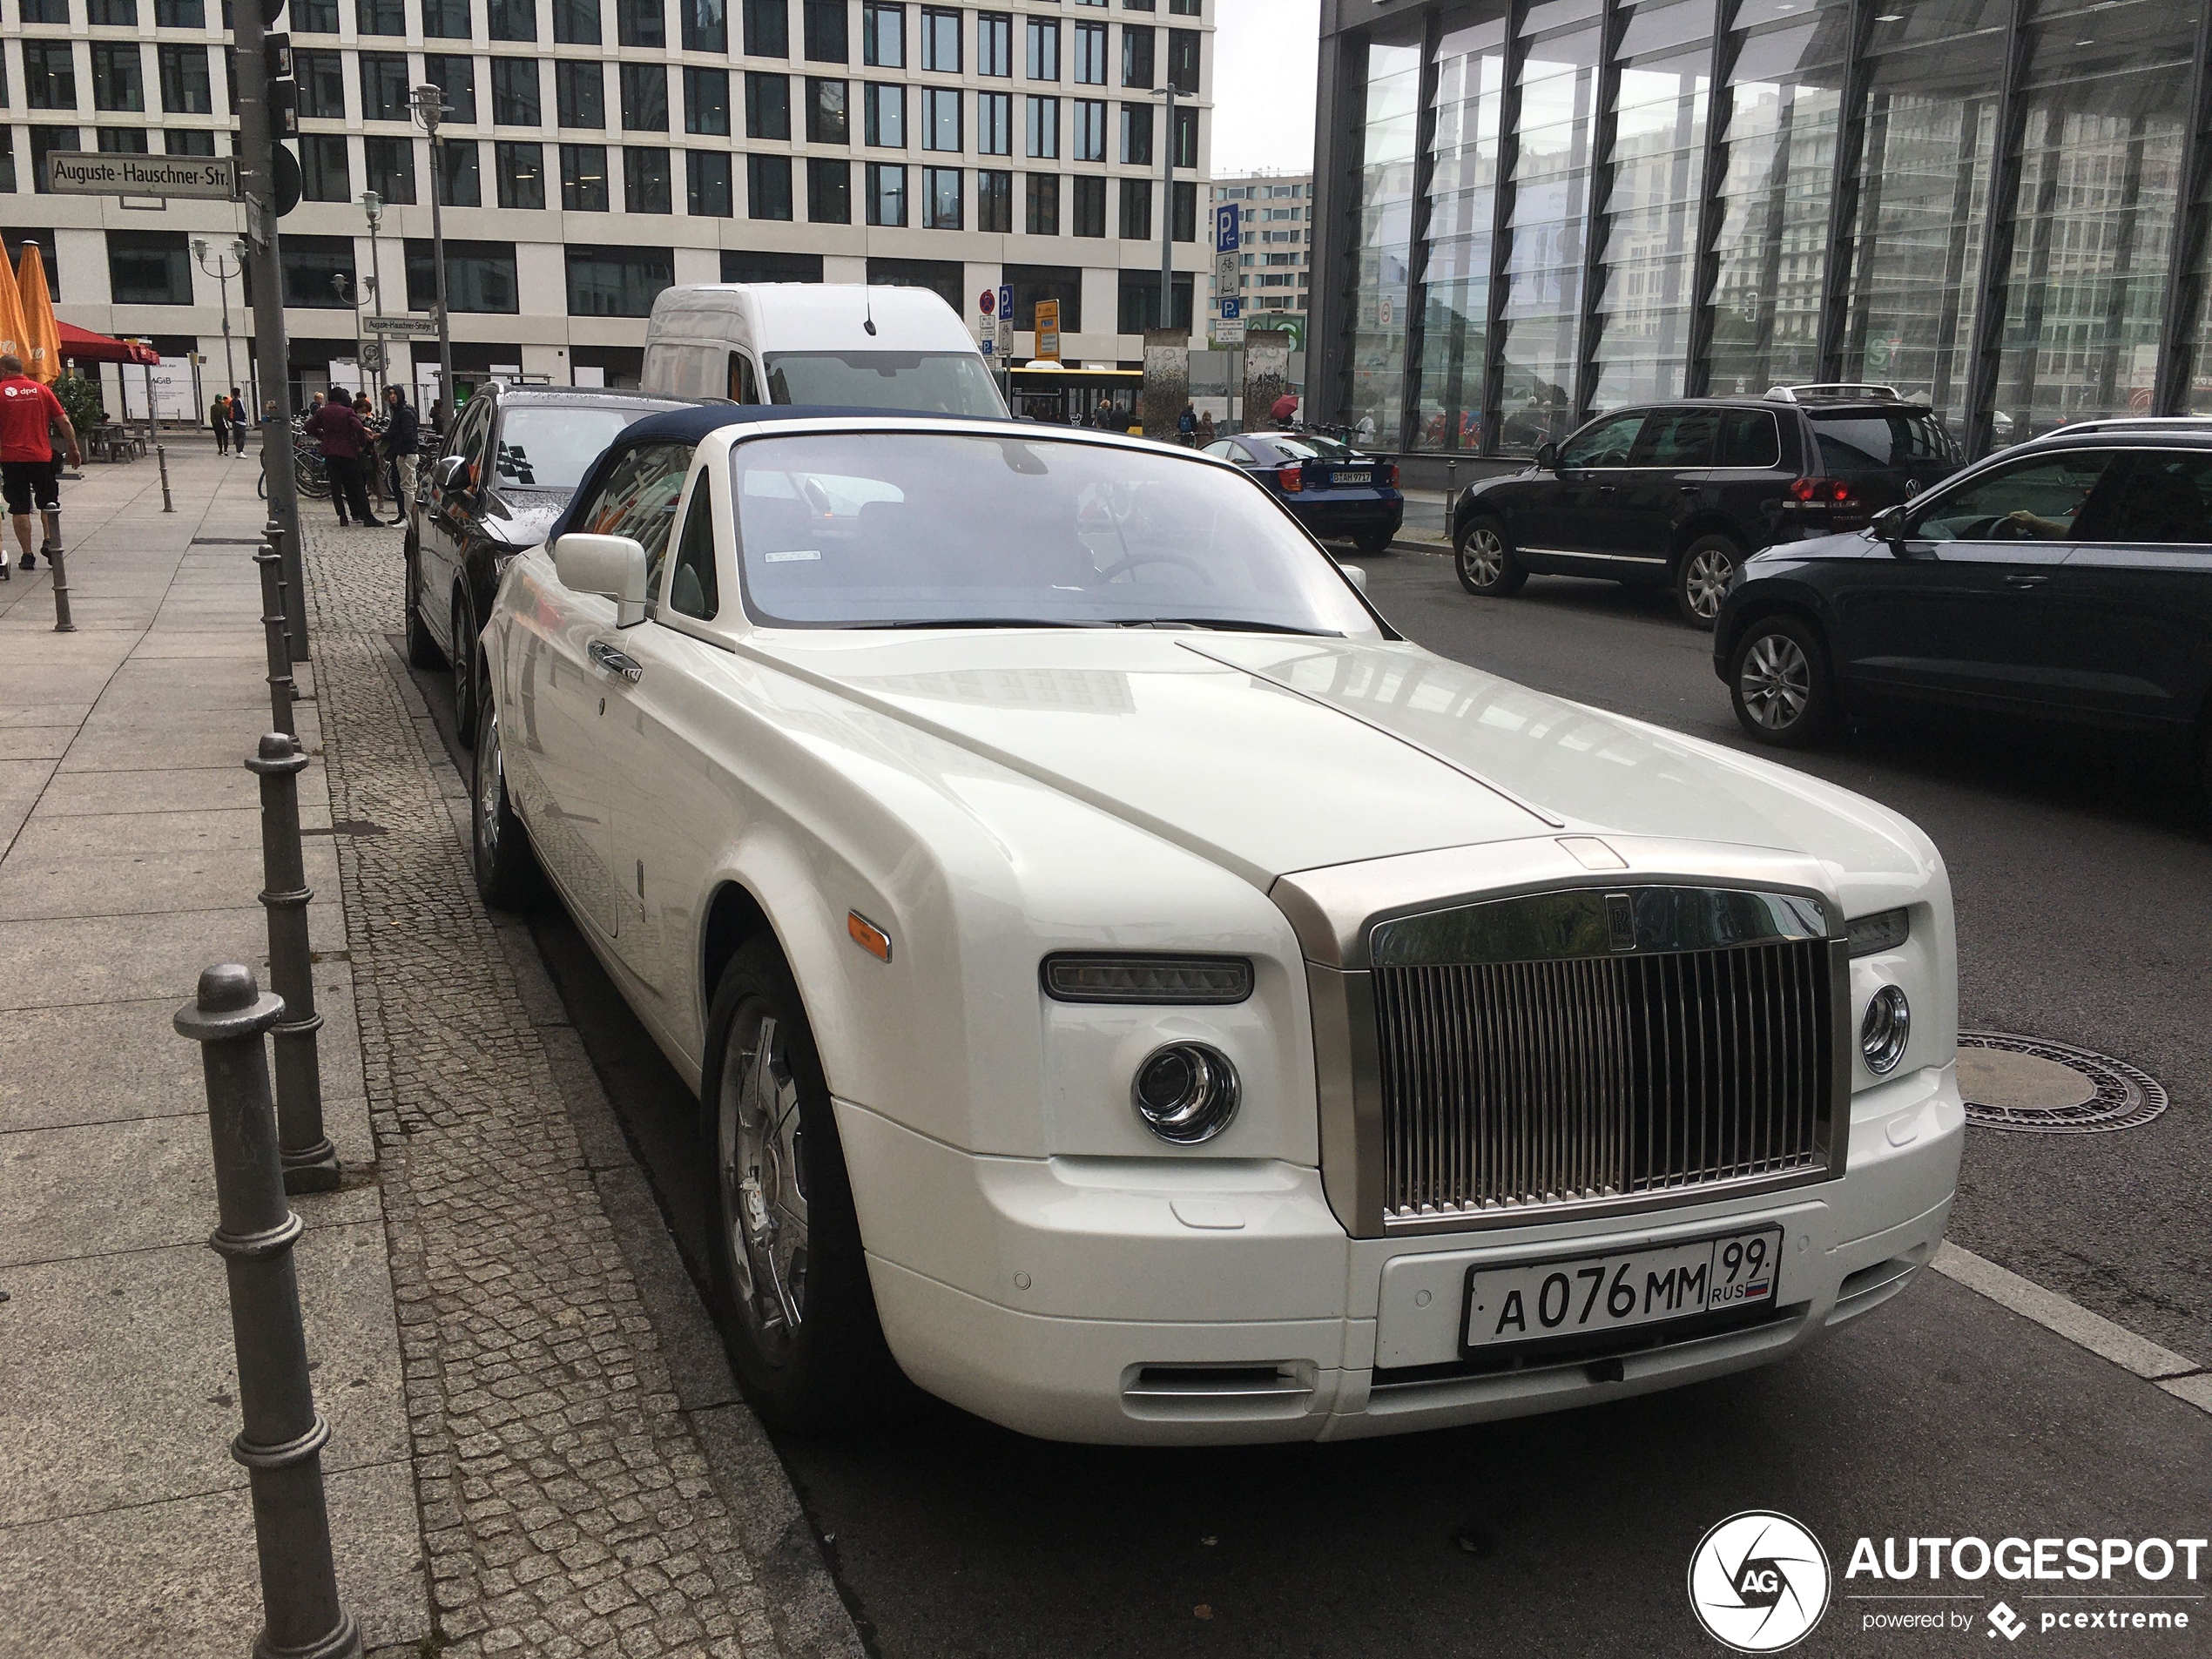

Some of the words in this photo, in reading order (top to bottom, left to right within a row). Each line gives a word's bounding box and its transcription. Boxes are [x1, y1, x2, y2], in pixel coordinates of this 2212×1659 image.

[1220, 212, 1232, 246] P
[1001, 290, 1009, 316] P
[1224, 301, 1234, 316] P
[983, 342, 990, 353] P
[20, 387, 37, 395] dpd
[1353, 473, 1370, 482] 9717
[1722, 1238, 1767, 1284] 99
[1712, 1283, 1744, 1303] RUS
